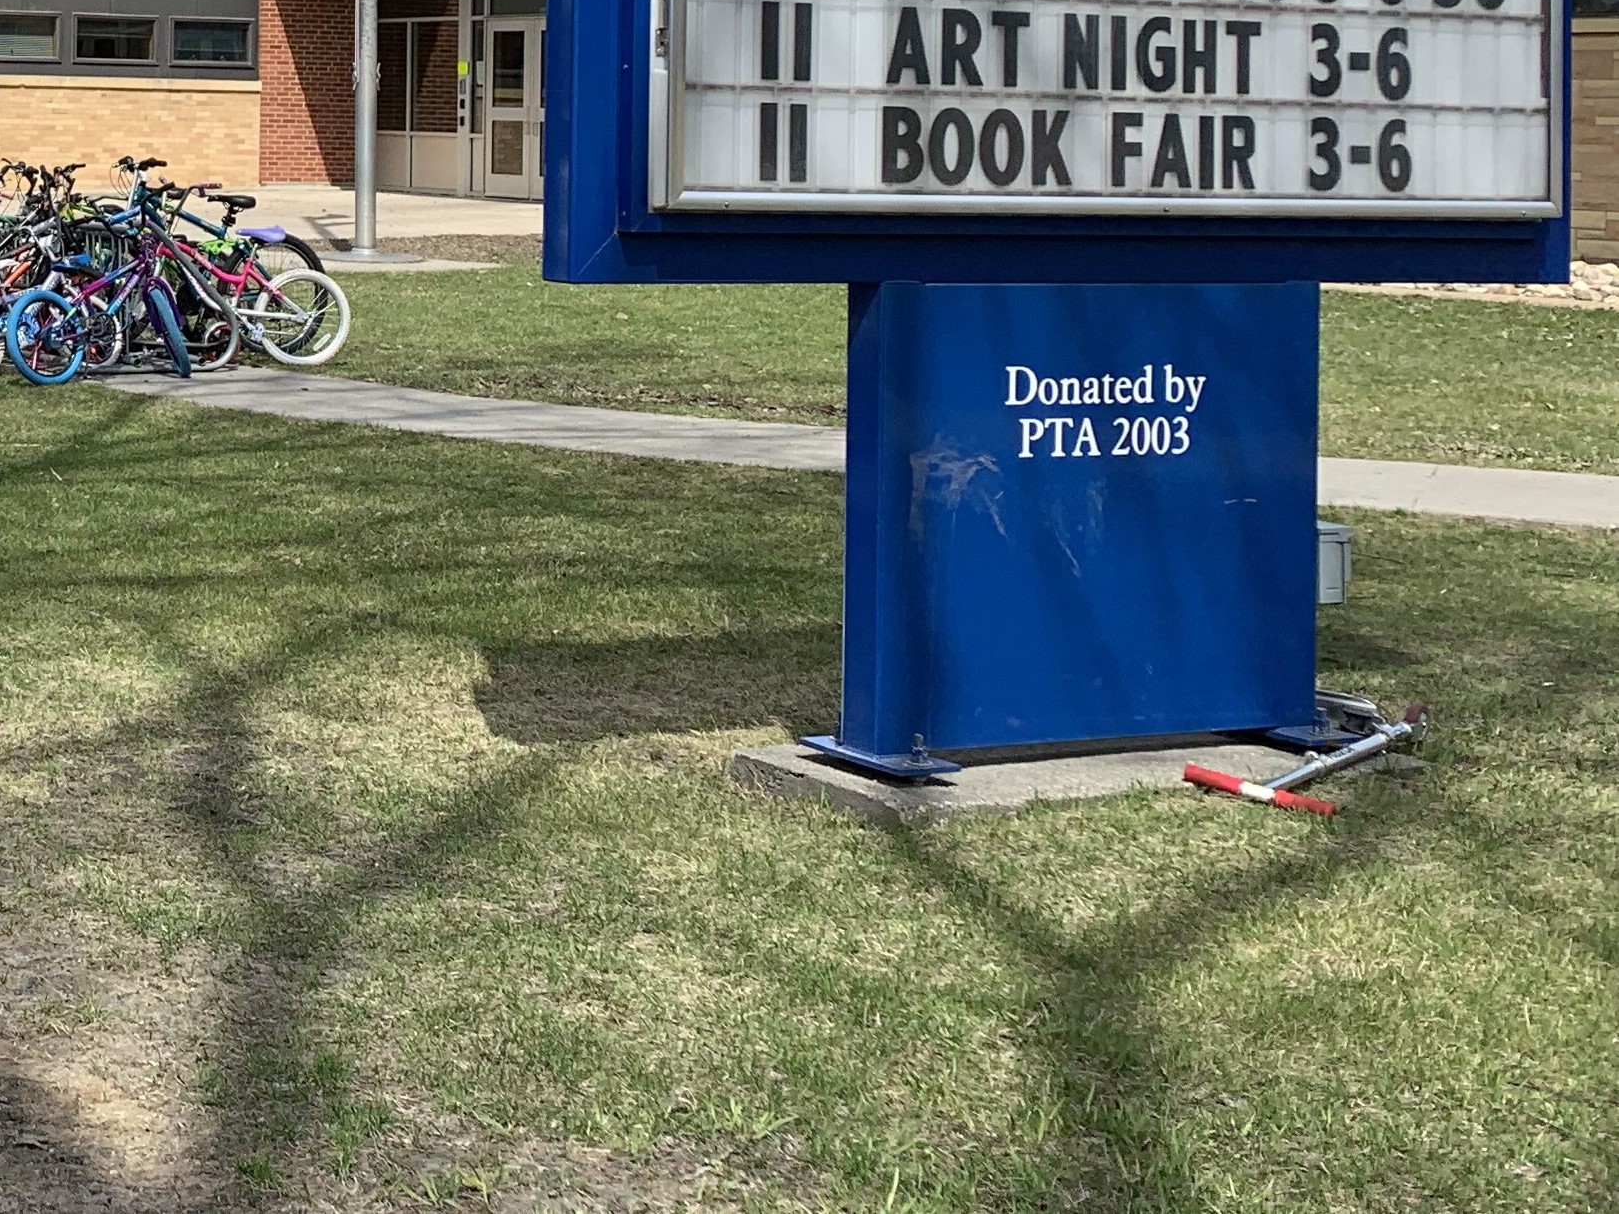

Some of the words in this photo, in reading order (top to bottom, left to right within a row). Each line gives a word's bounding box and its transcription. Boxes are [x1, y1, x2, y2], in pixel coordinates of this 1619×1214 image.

[885, 6, 1031, 88] ART
[1063, 13, 1263, 95] NIGHT
[1309, 23, 1412, 102] 3-6
[881, 105, 1073, 187] BOOK
[1111, 111, 1256, 191] FAIR
[1308, 116, 1412, 193] 3-6
[1004, 364, 1155, 406] Donated
[1163, 363, 1207, 413] by
[1018, 417, 1102, 458] PTA
[1111, 416, 1190, 456] 2003
